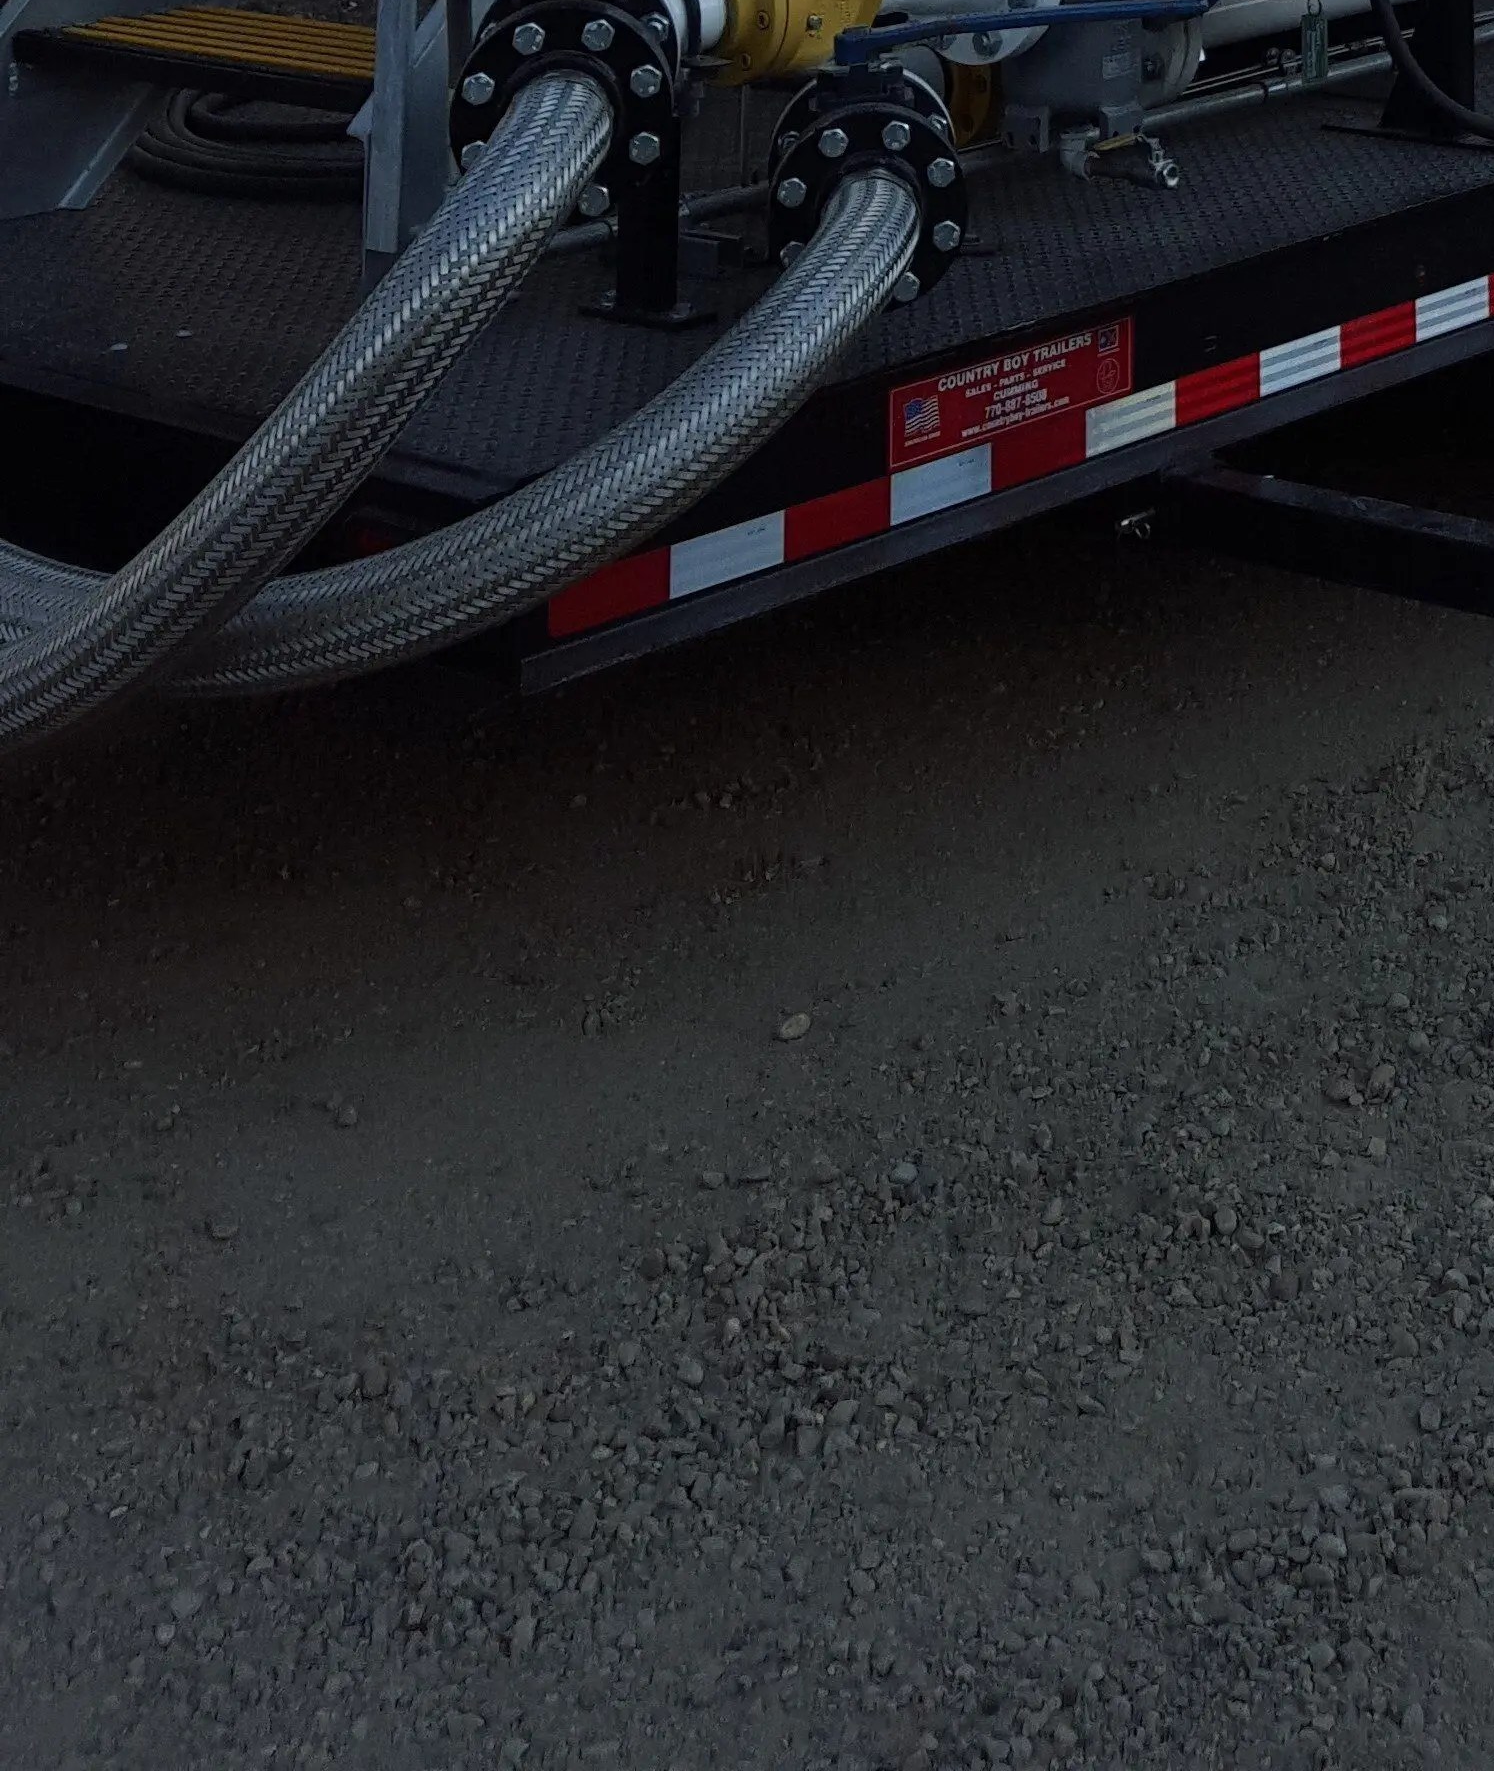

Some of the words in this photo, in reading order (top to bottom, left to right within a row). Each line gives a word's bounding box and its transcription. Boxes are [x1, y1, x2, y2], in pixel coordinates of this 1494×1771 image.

[938, 362, 1000, 392] COUNTRY
[1003, 353, 1031, 372] BOY
[1033, 332, 1092, 362] TRAILERS
